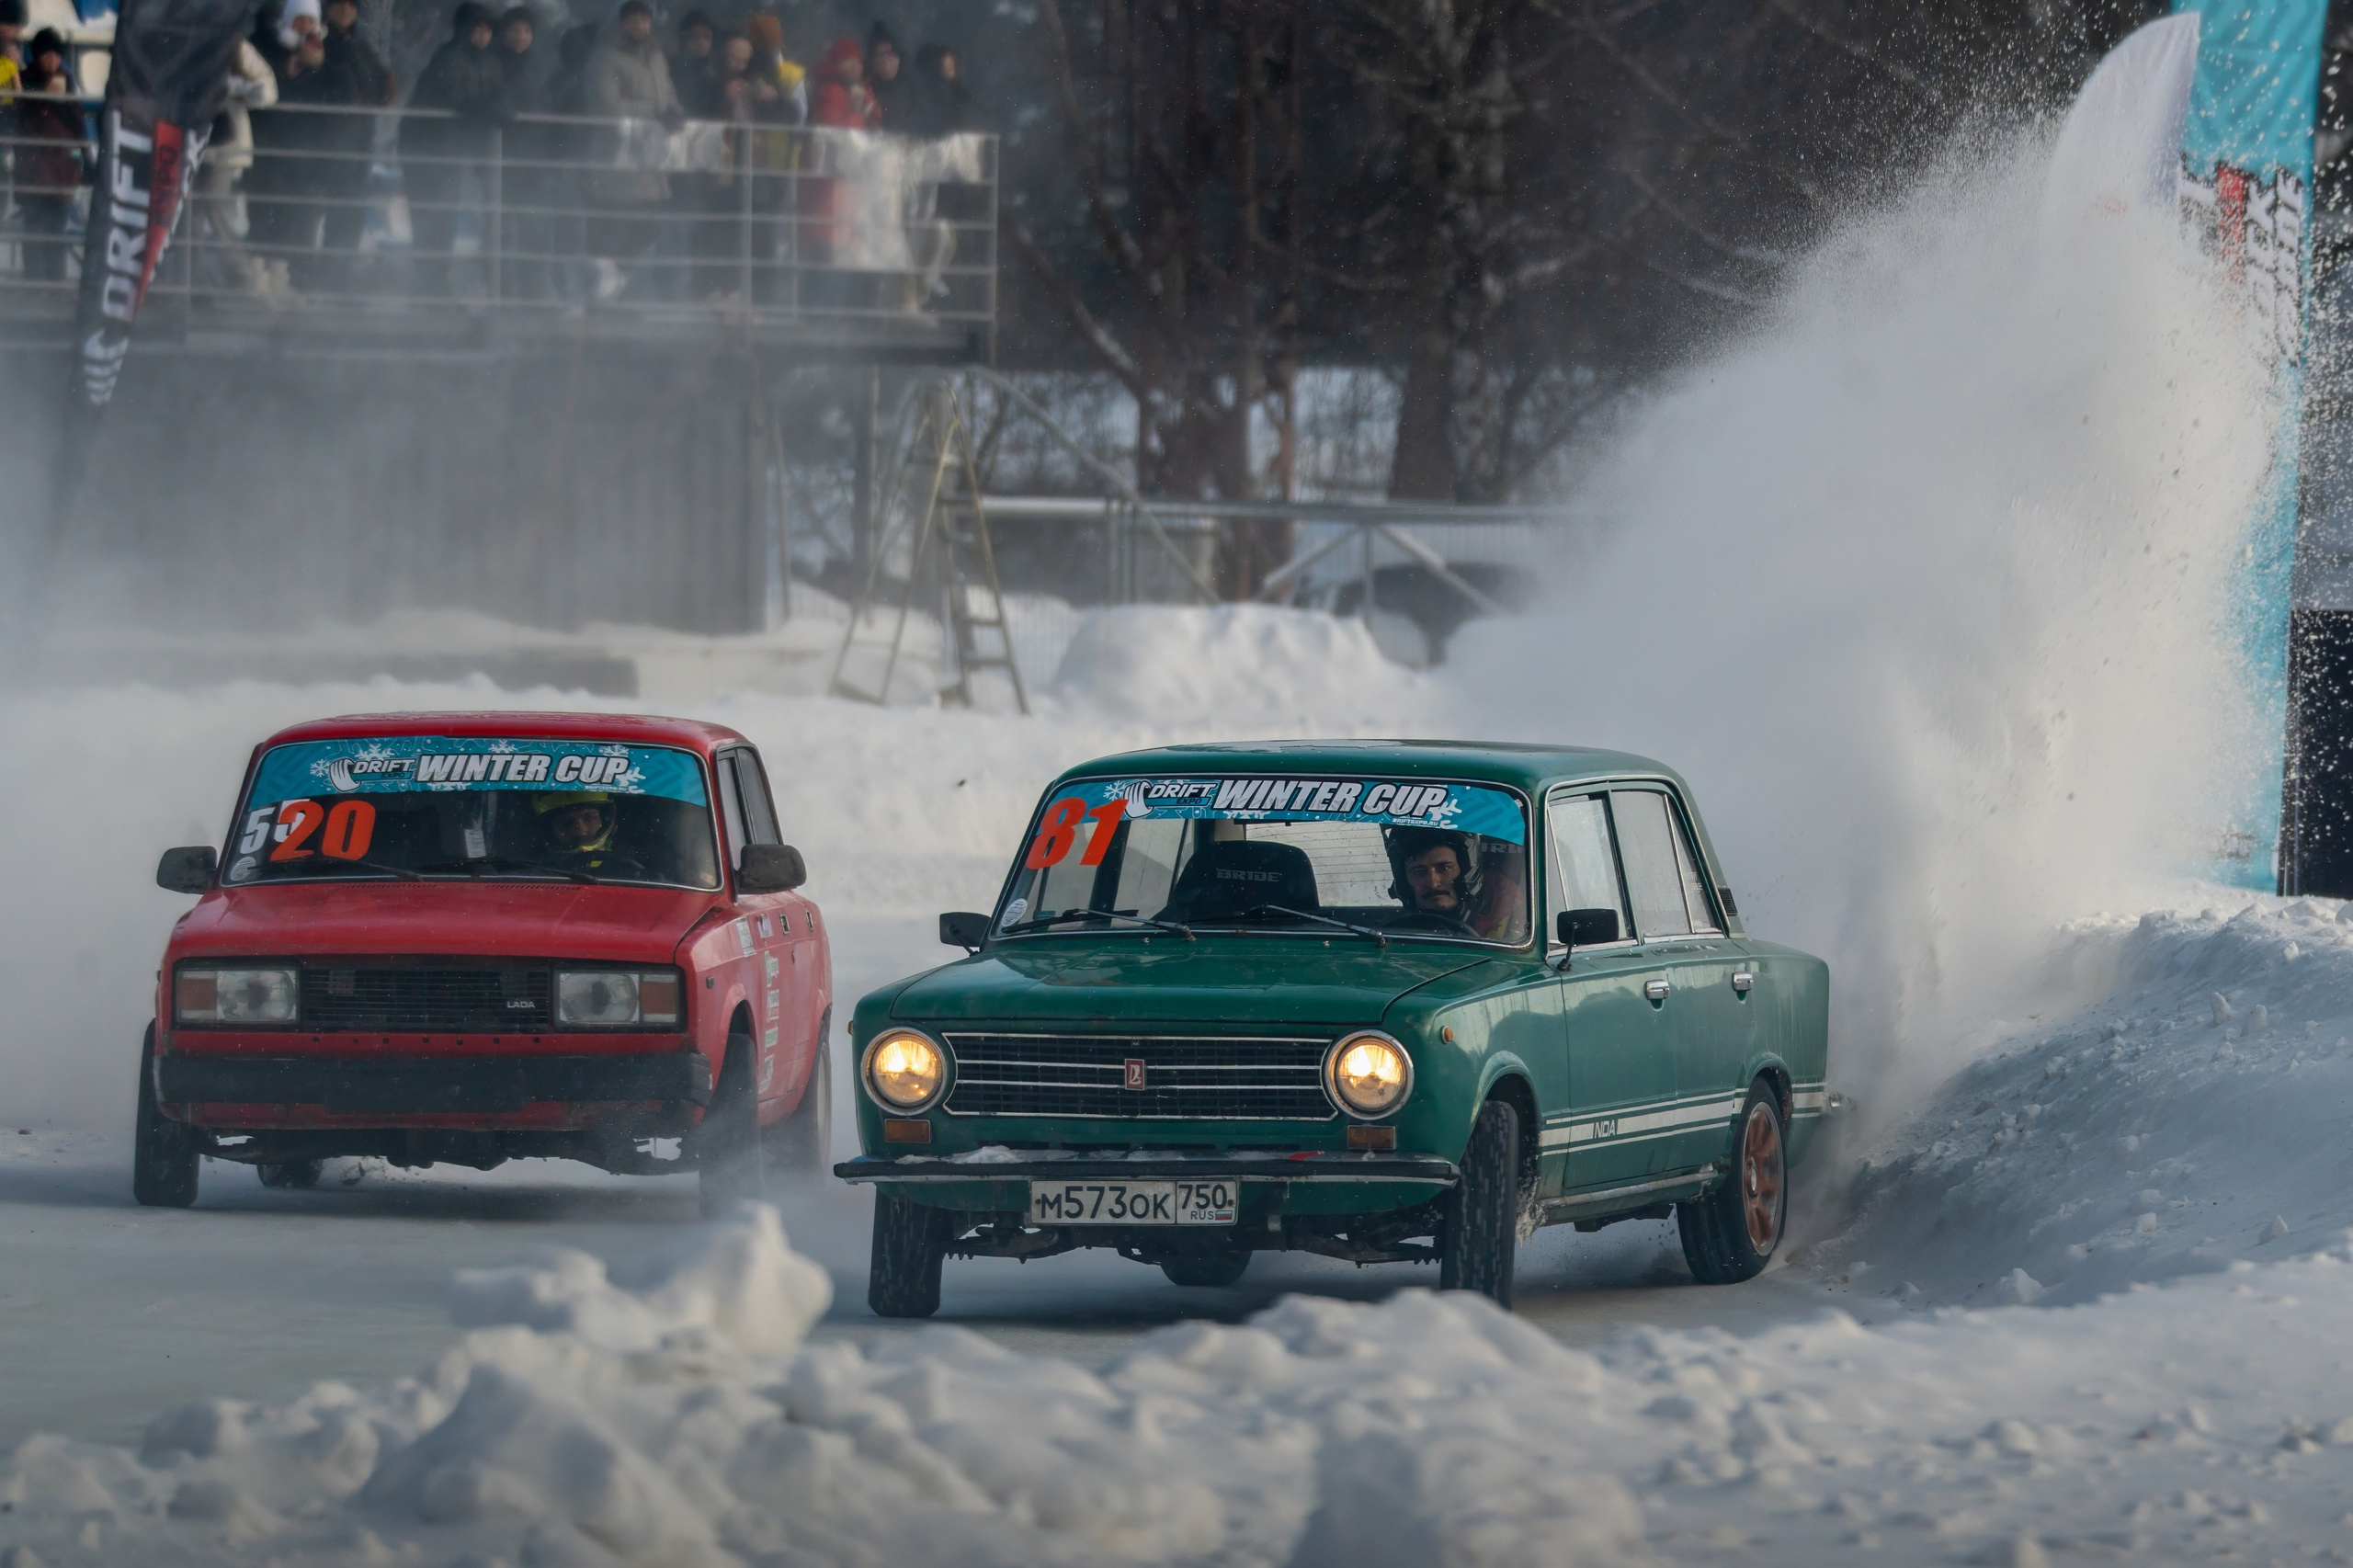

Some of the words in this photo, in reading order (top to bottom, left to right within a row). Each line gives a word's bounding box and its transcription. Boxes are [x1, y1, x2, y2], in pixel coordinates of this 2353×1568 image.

[102, 109, 153, 322] DRIFT
[353, 759, 416, 774] DRIFT
[417, 754, 551, 782] WINTER
[555, 755, 630, 784] CUP
[1148, 782, 1219, 798] DRIFT
[1211, 778, 1362, 812] WINTER
[1362, 783, 1449, 815] CUP
[269, 800, 377, 862] 20
[1026, 797, 1130, 869] 81
[1216, 869, 1280, 881] BRIDE
[1178, 1184, 1228, 1210] 750
[1190, 1210, 1214, 1221] RUS
